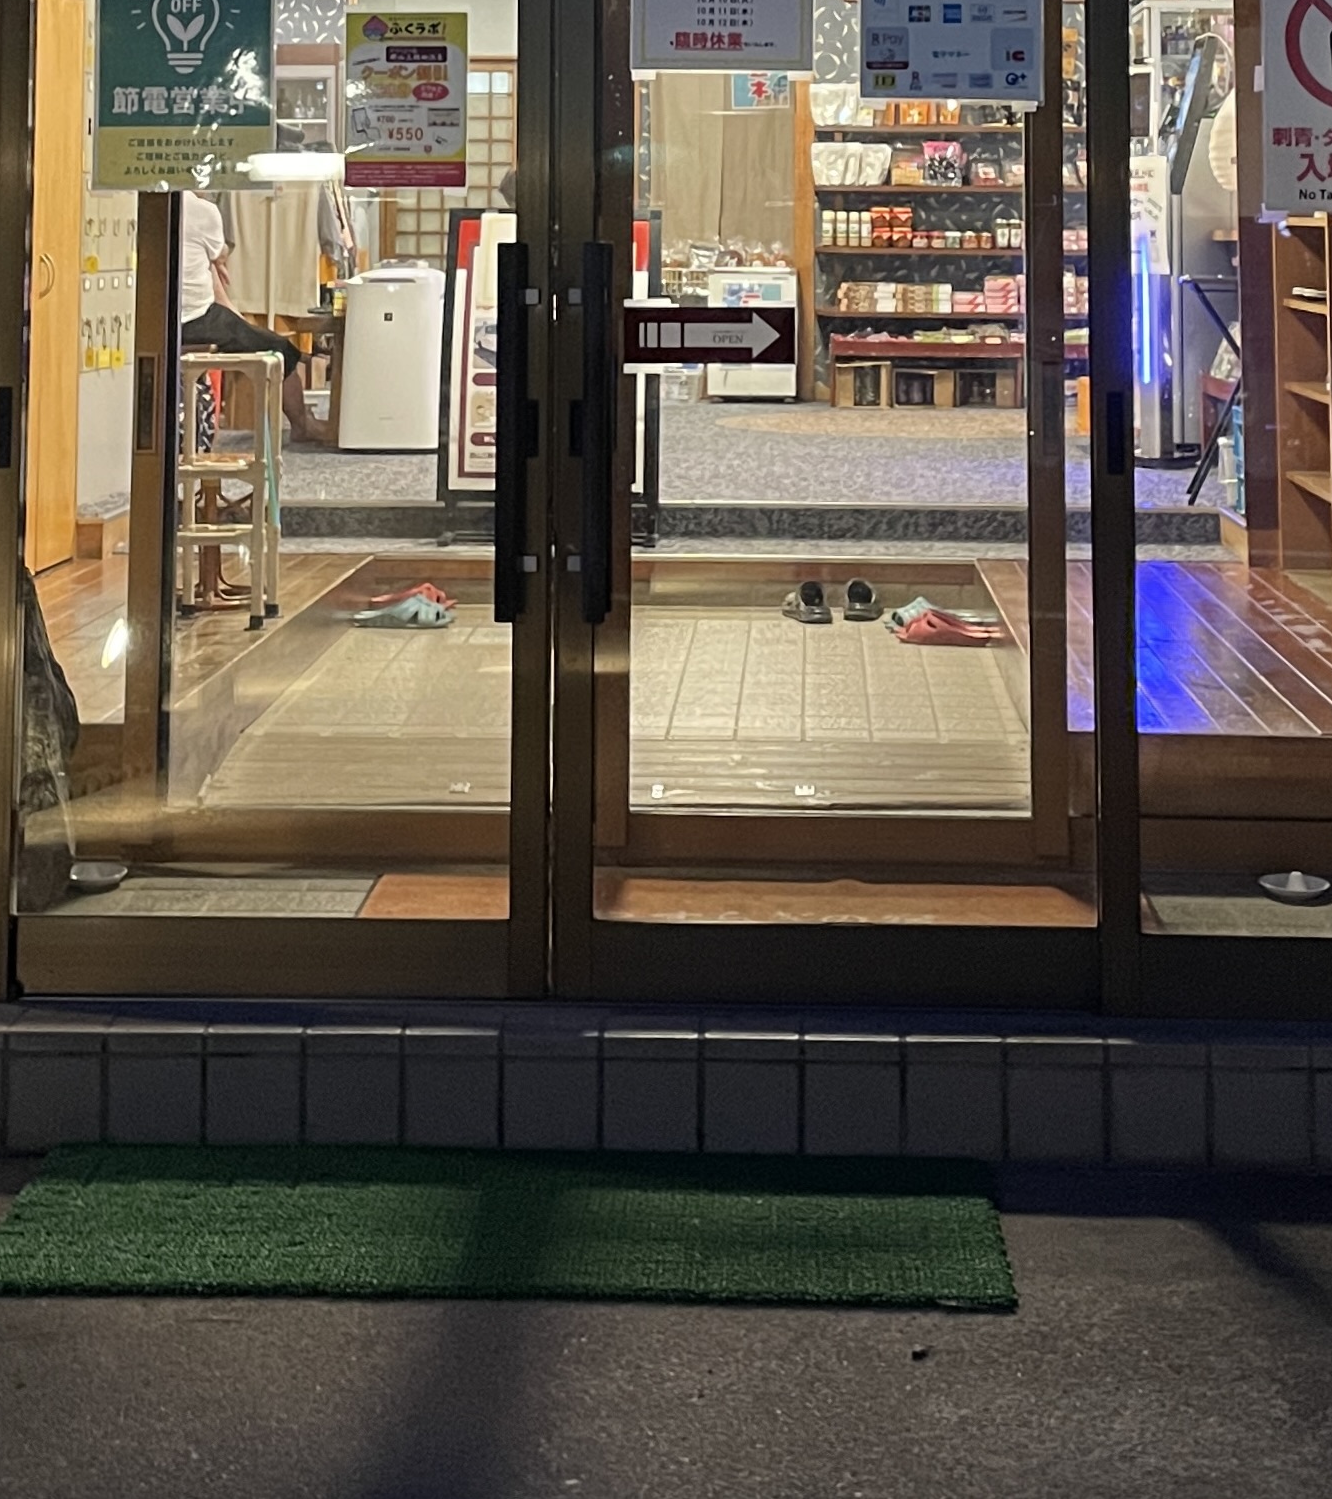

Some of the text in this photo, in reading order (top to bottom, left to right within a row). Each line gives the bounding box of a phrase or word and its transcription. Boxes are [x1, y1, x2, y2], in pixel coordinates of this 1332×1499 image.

[388, 127, 424, 141] ¥550
[1298, 188, 1316, 201] No
[712, 334, 744, 344] OPEN
